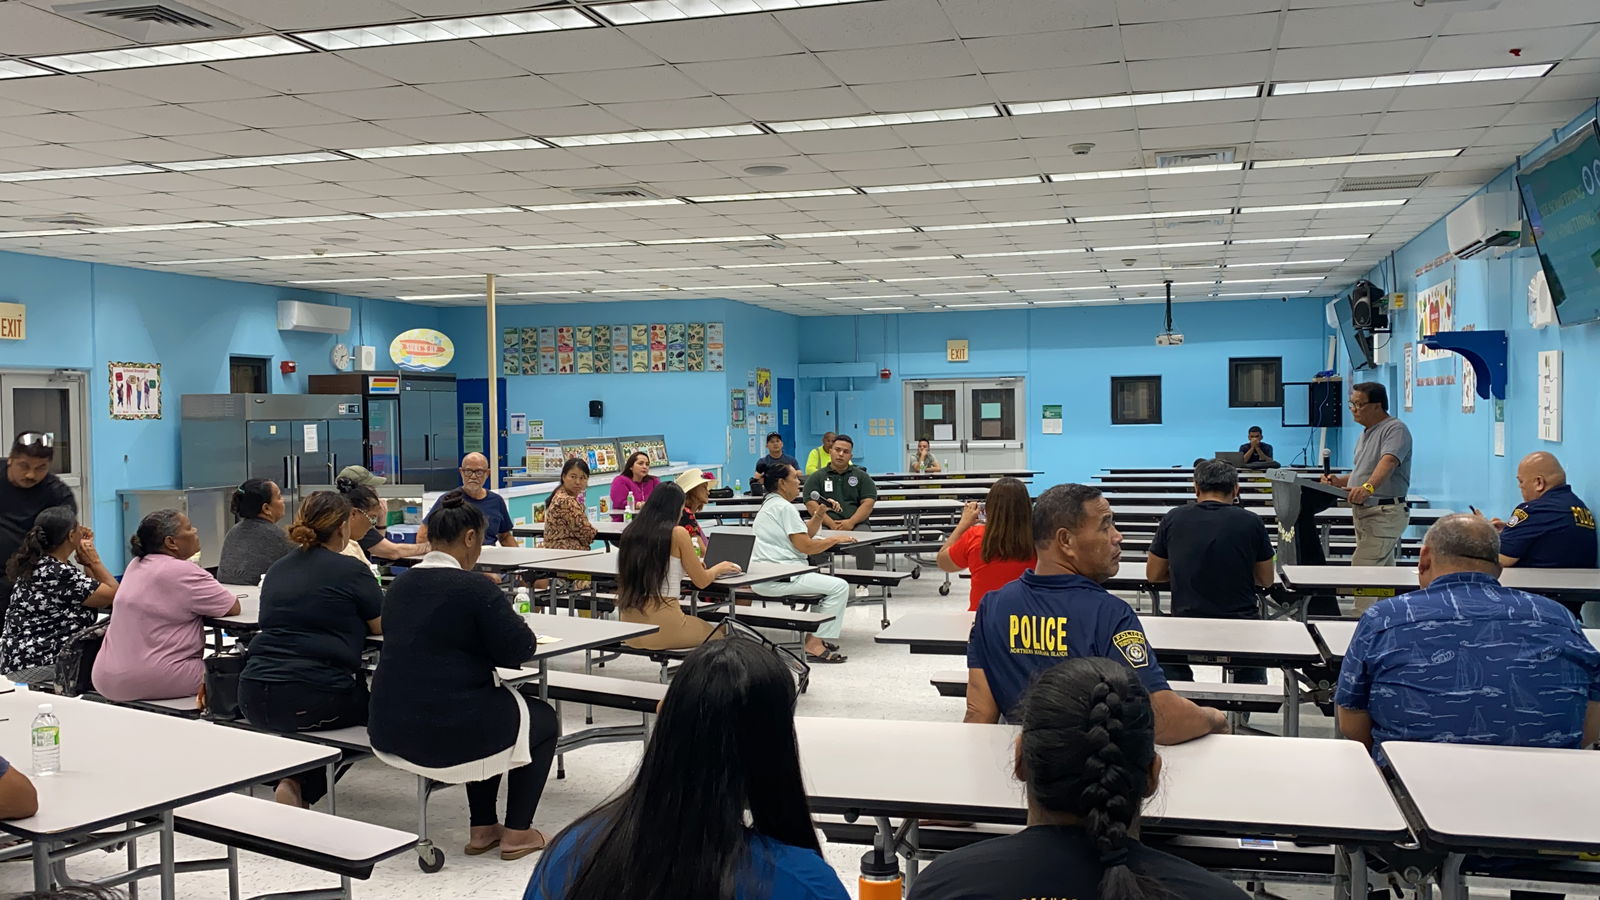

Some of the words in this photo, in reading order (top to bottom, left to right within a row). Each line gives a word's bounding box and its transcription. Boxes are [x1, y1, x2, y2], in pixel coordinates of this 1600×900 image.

[1, 318, 22, 338] EXIT
[950, 348, 966, 360] EXIT
[1009, 614, 1068, 651] POLICE
